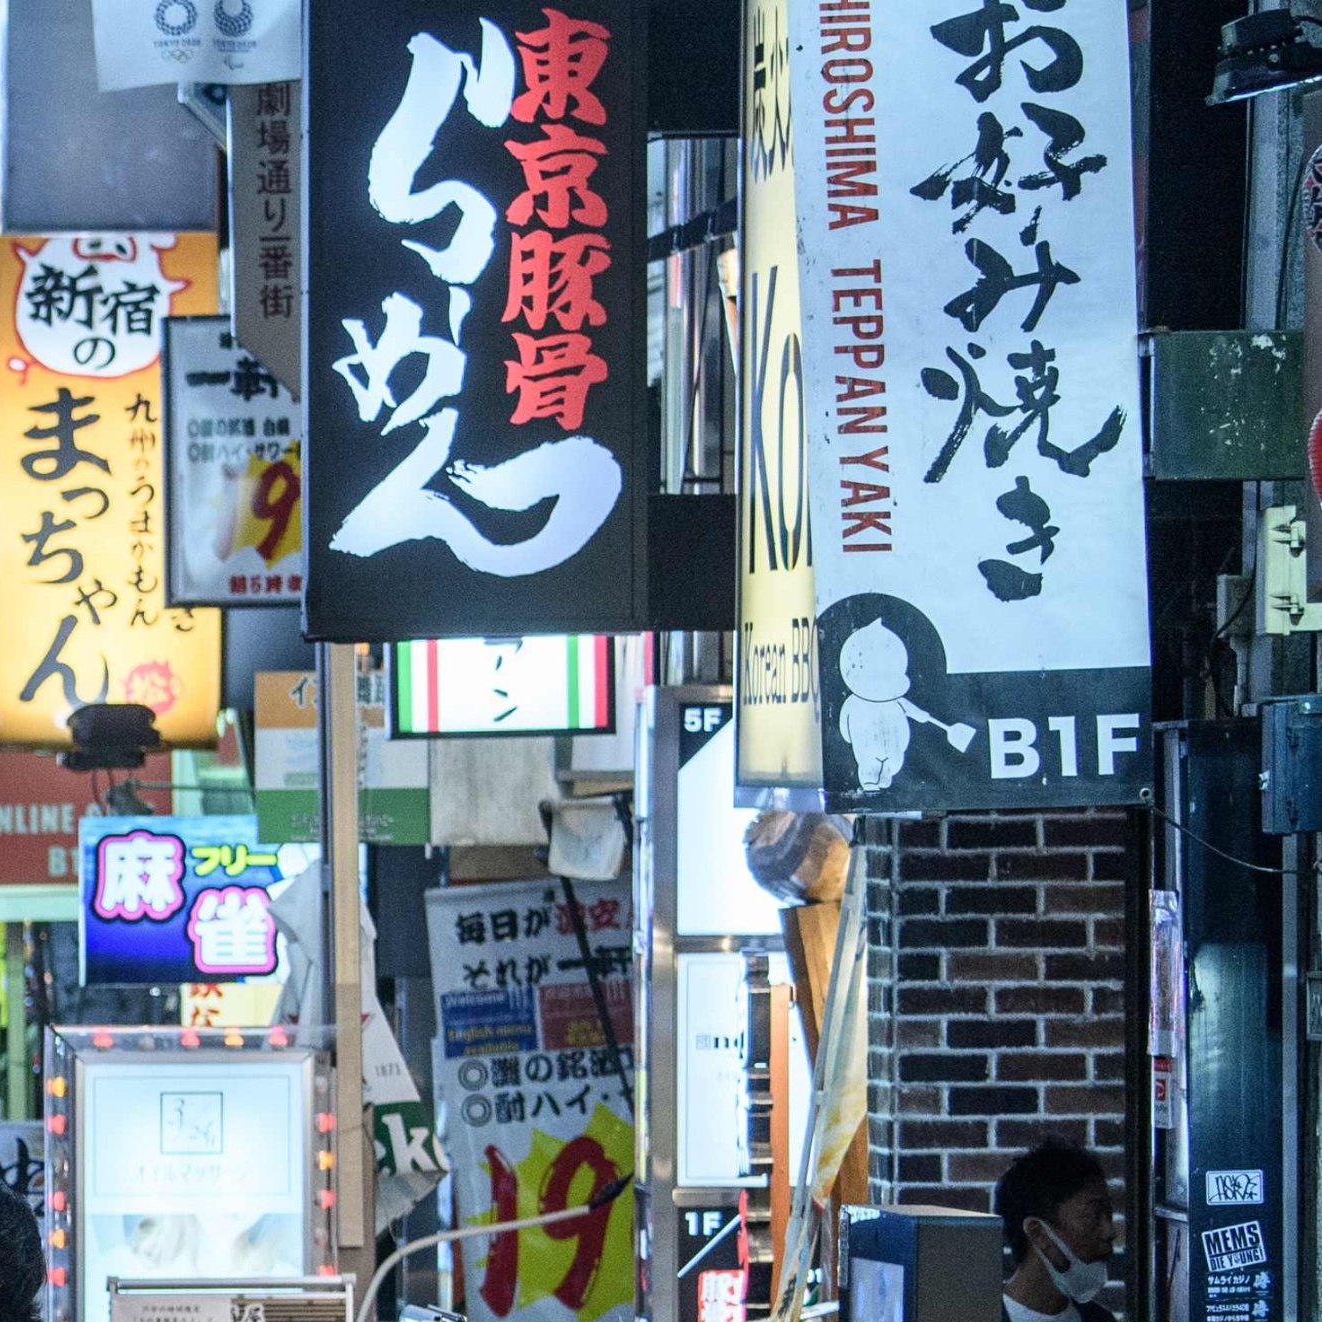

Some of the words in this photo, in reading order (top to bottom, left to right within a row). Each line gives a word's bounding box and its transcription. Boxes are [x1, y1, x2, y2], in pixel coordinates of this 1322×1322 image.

[256, 82, 294, 320] 劇場通り一番街
[501, 7, 612, 431] 東京豚骨
[25, 263, 161, 338] 新宿
[910, 0, 1127, 602] お好み焼き
[73, 336, 118, 370] の
[749, 264, 812, 577] Ko
[829, 259, 893, 553] TEPPANYAKI
[742, 620, 787, 706] Korean
[683, 706, 722, 733] 5F
[989, 713, 1141, 779] B1F
[190, 844, 279, 877] フリー
[684, 1211, 723, 1236] 1F
[1203, 1223, 1261, 1256] MEMS
